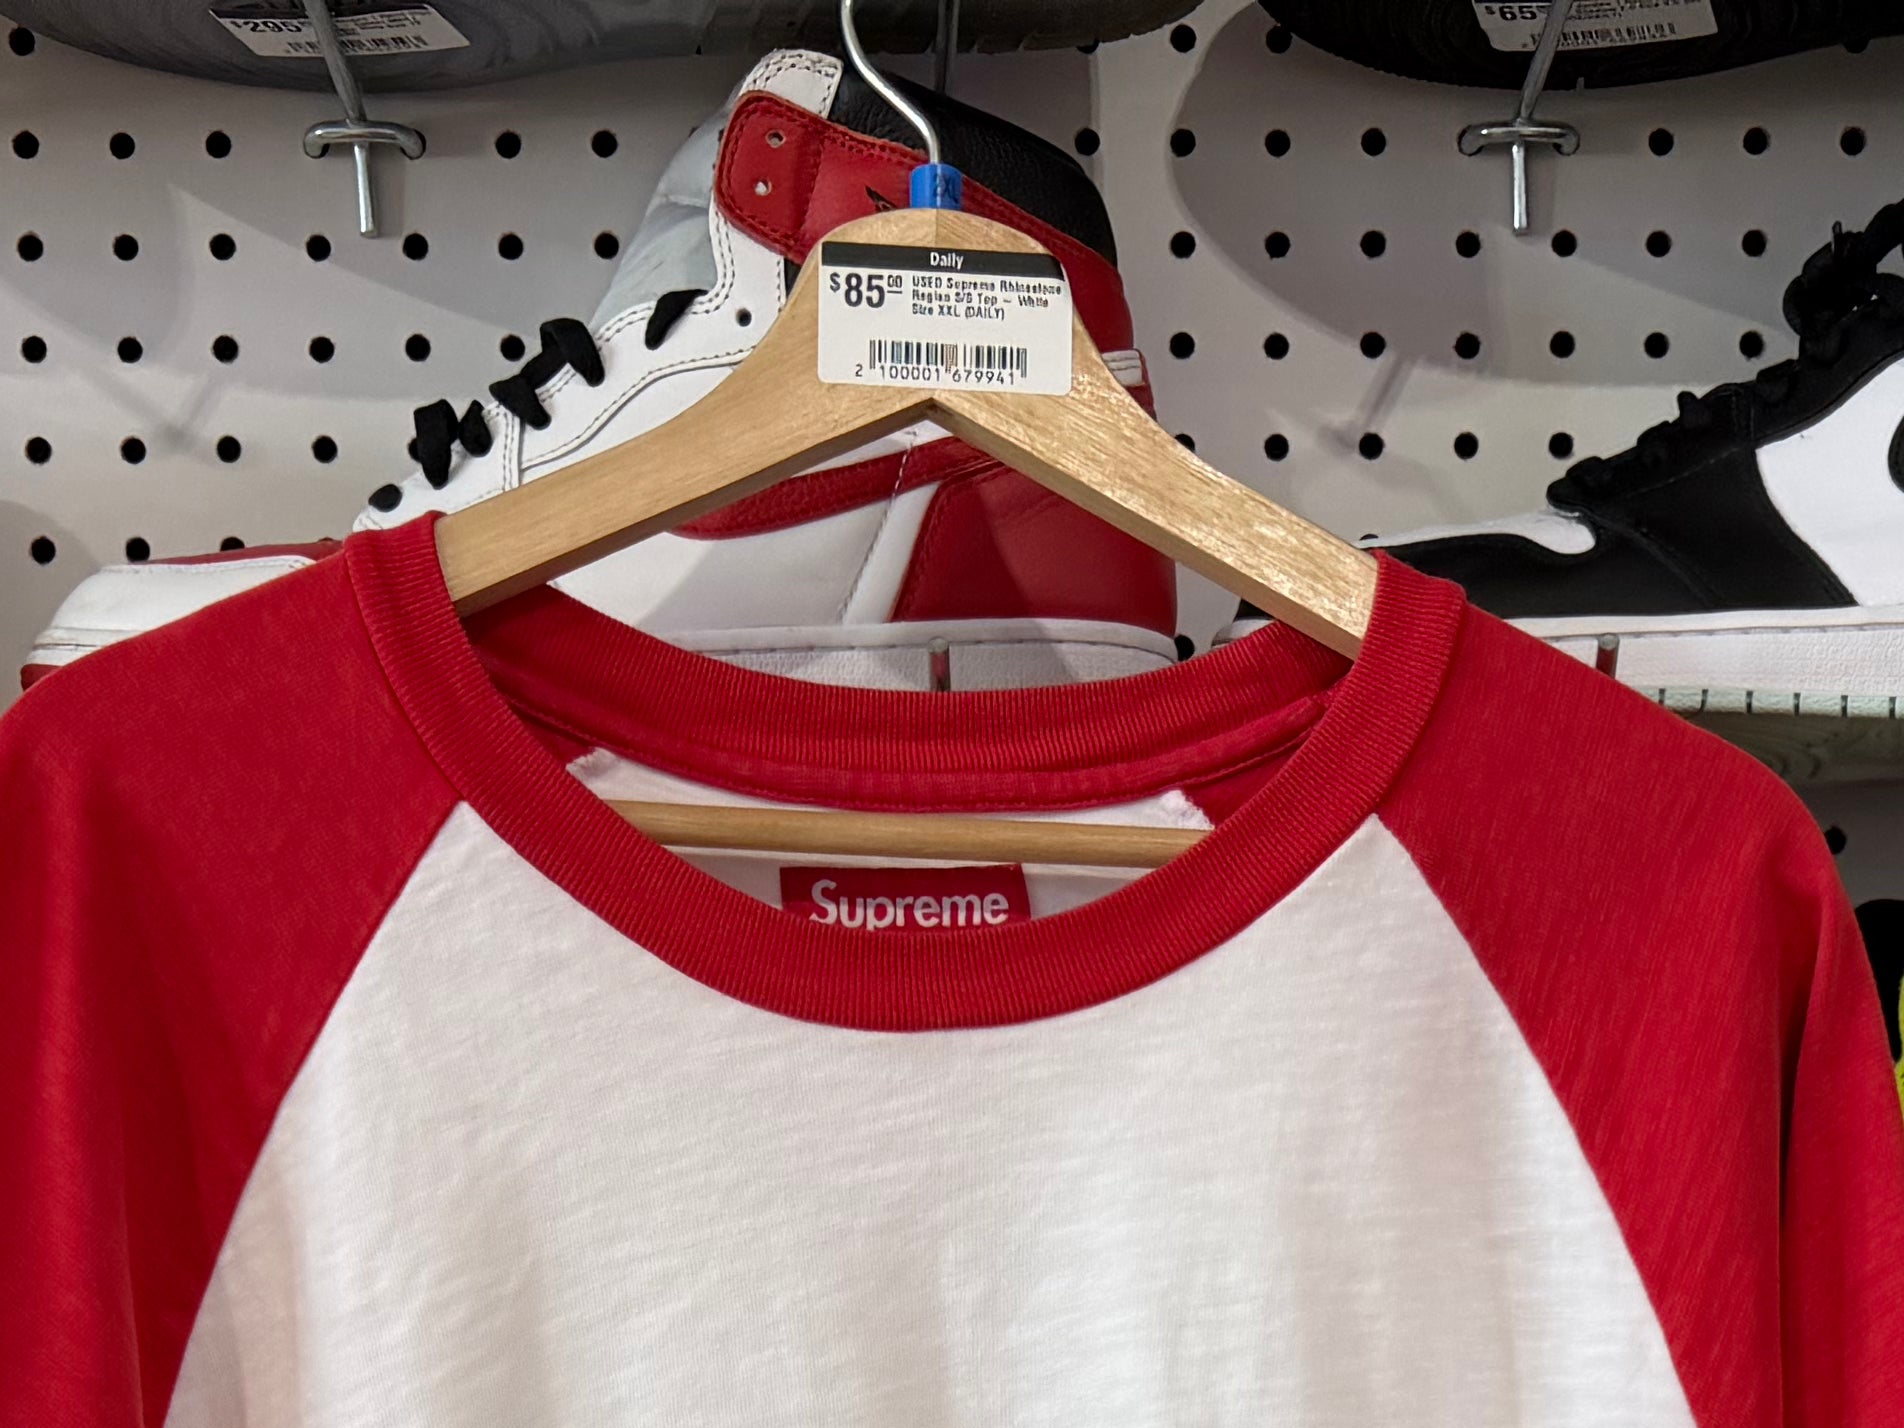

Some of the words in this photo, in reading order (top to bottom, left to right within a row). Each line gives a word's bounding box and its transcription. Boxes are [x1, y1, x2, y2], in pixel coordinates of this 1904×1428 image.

[929, 251, 964, 270] Daily
[912, 275, 943, 289] USED
[946, 277, 995, 293] Supreme
[977, 293, 998, 307] Top
[938, 304, 961, 318] XXL
[964, 306, 1005, 321] (DAILY)
[855, 364, 863, 378] 2
[880, 365, 941, 381] 100001
[952, 369, 1015, 386] 679941
[809, 879, 1009, 931] Supreme
